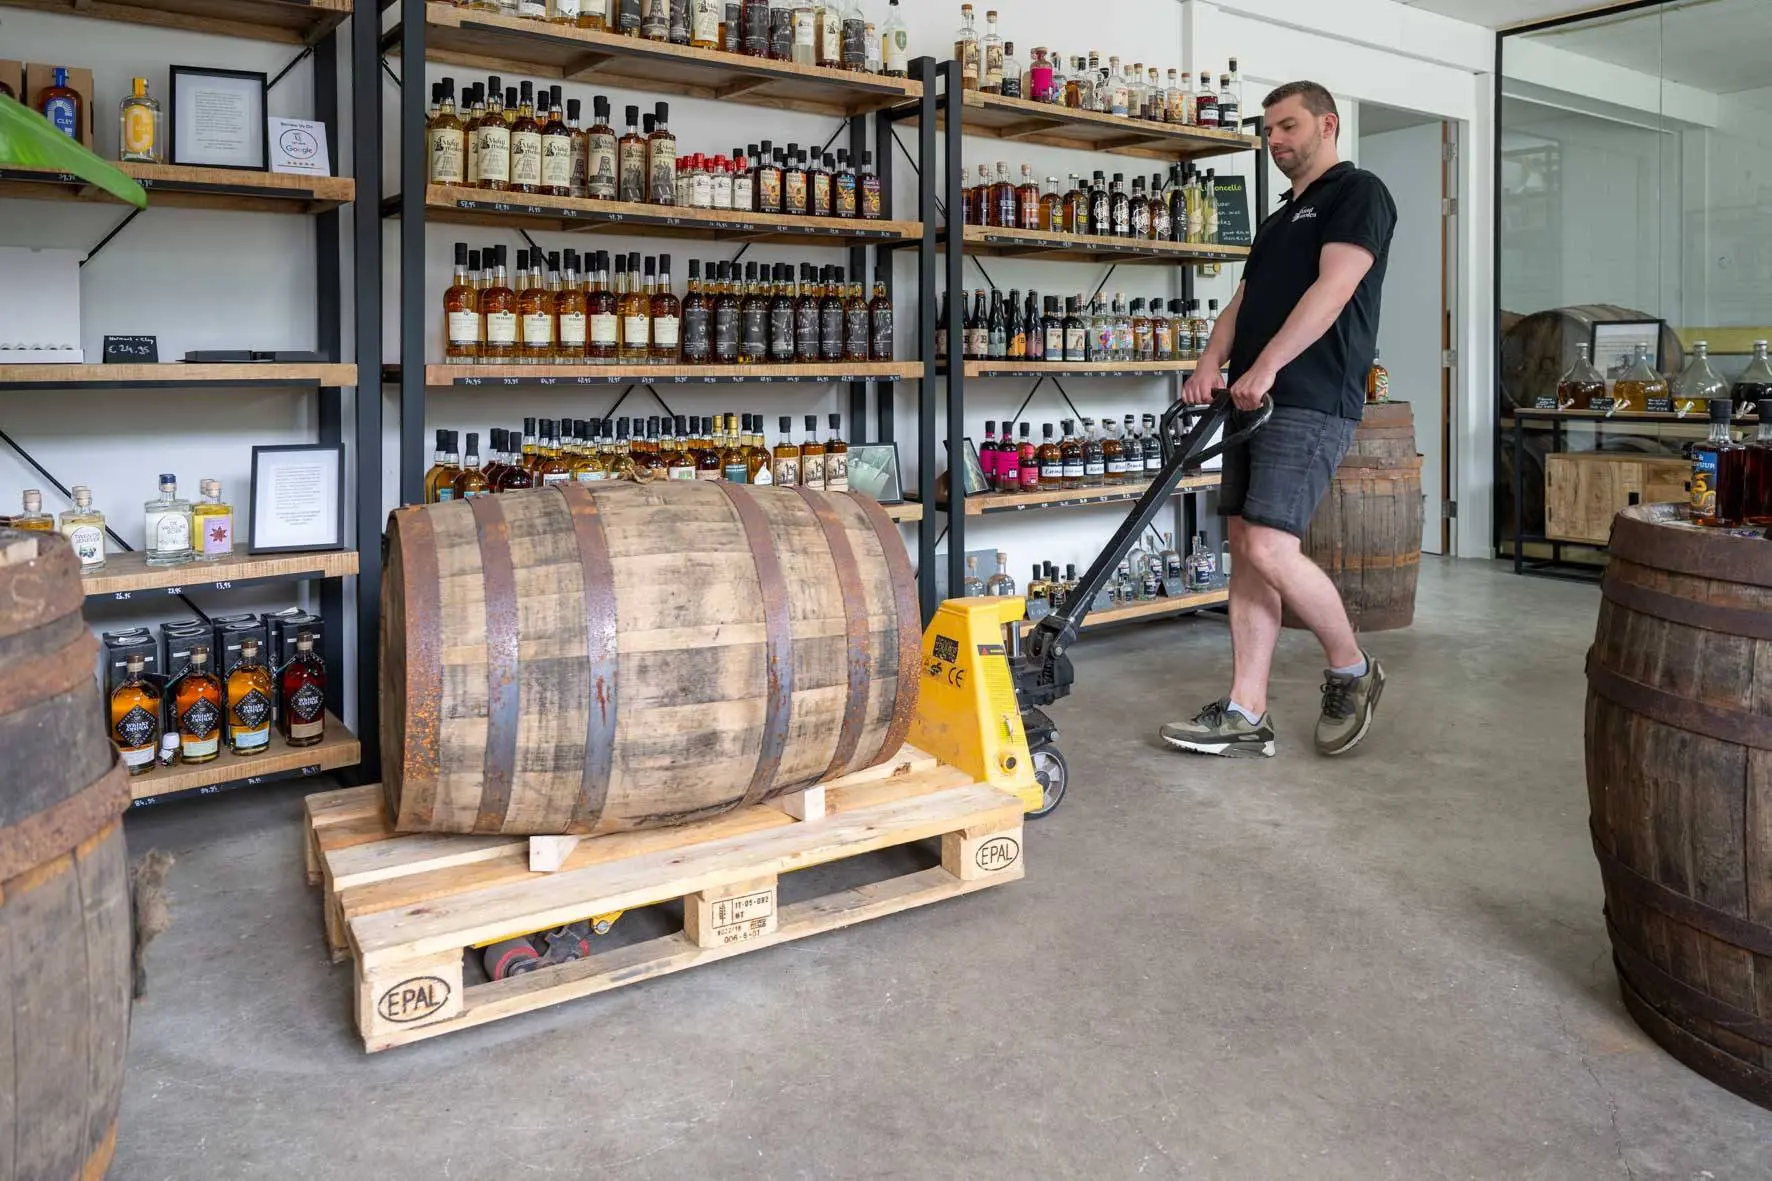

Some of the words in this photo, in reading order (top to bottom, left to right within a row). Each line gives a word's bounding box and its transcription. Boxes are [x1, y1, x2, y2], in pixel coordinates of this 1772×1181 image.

[1200, 184, 1242, 192] Lioncello
[981, 843, 1013, 866] EPAL
[388, 984, 441, 1017] EPAL
